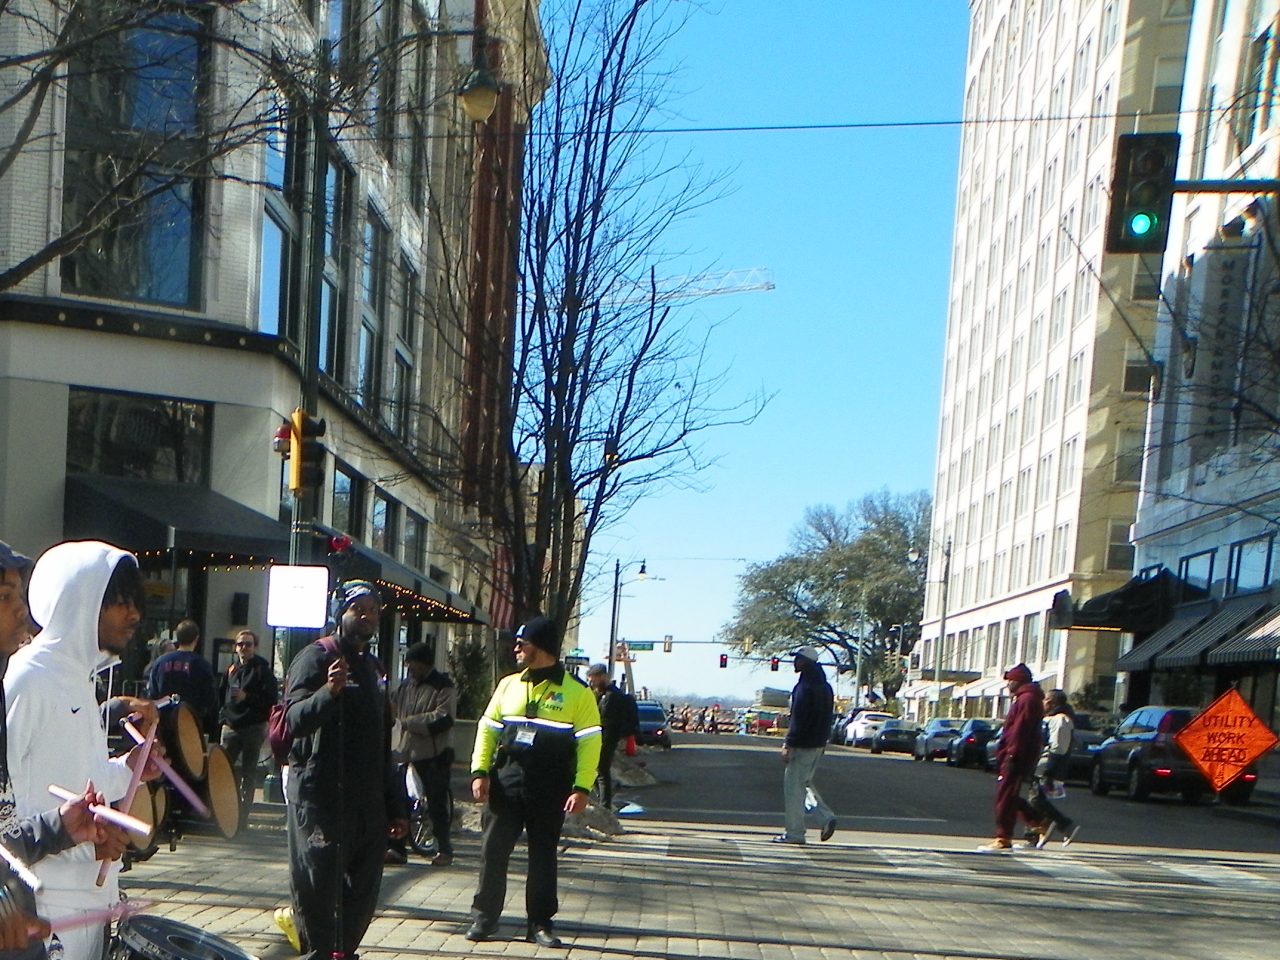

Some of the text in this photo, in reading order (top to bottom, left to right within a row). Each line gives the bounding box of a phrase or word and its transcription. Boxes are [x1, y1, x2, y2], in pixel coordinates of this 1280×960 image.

[1202, 715, 1257, 728] UTILITY
[1206, 732, 1246, 745] WORK
[1201, 747, 1247, 762] AHEAD
